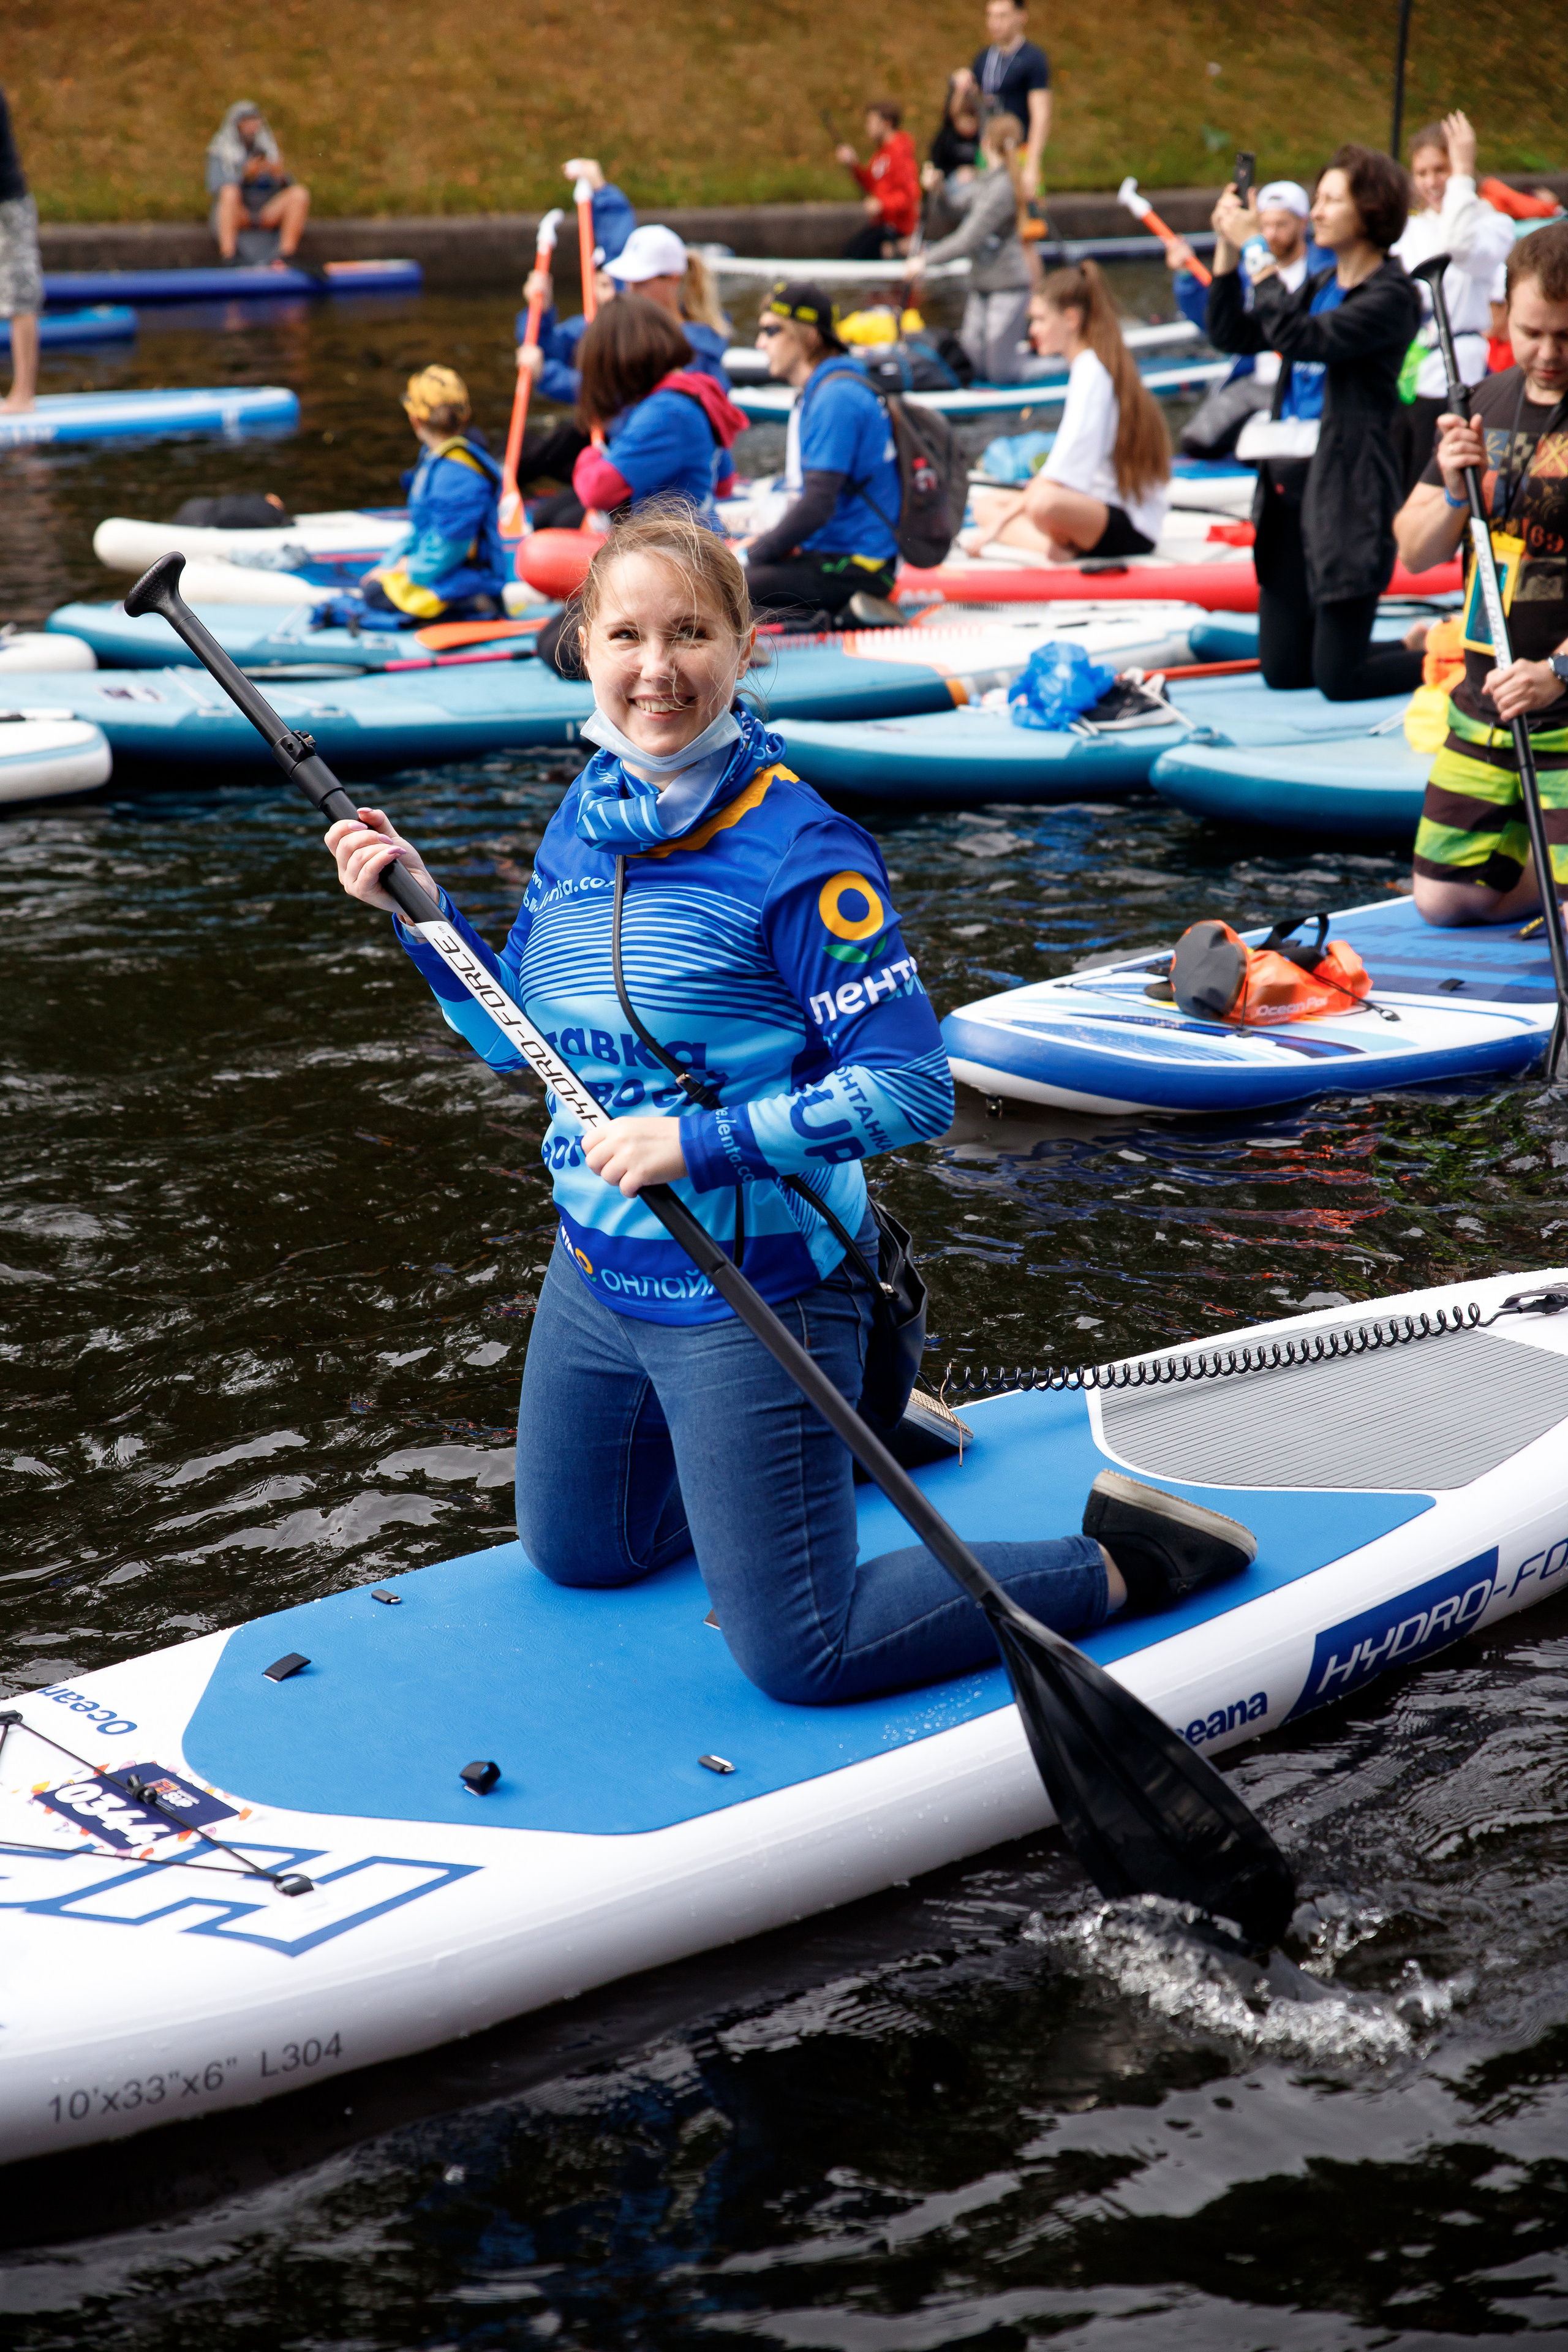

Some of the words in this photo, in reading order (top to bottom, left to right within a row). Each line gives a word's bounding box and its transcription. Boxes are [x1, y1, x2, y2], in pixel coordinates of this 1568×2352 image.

[600, 1268, 715, 1300] онлай
[1316, 1537, 1568, 1695] HYDRO-FO
[1175, 1692, 1268, 1746] eana
[260, 2030, 343, 2078] L304
